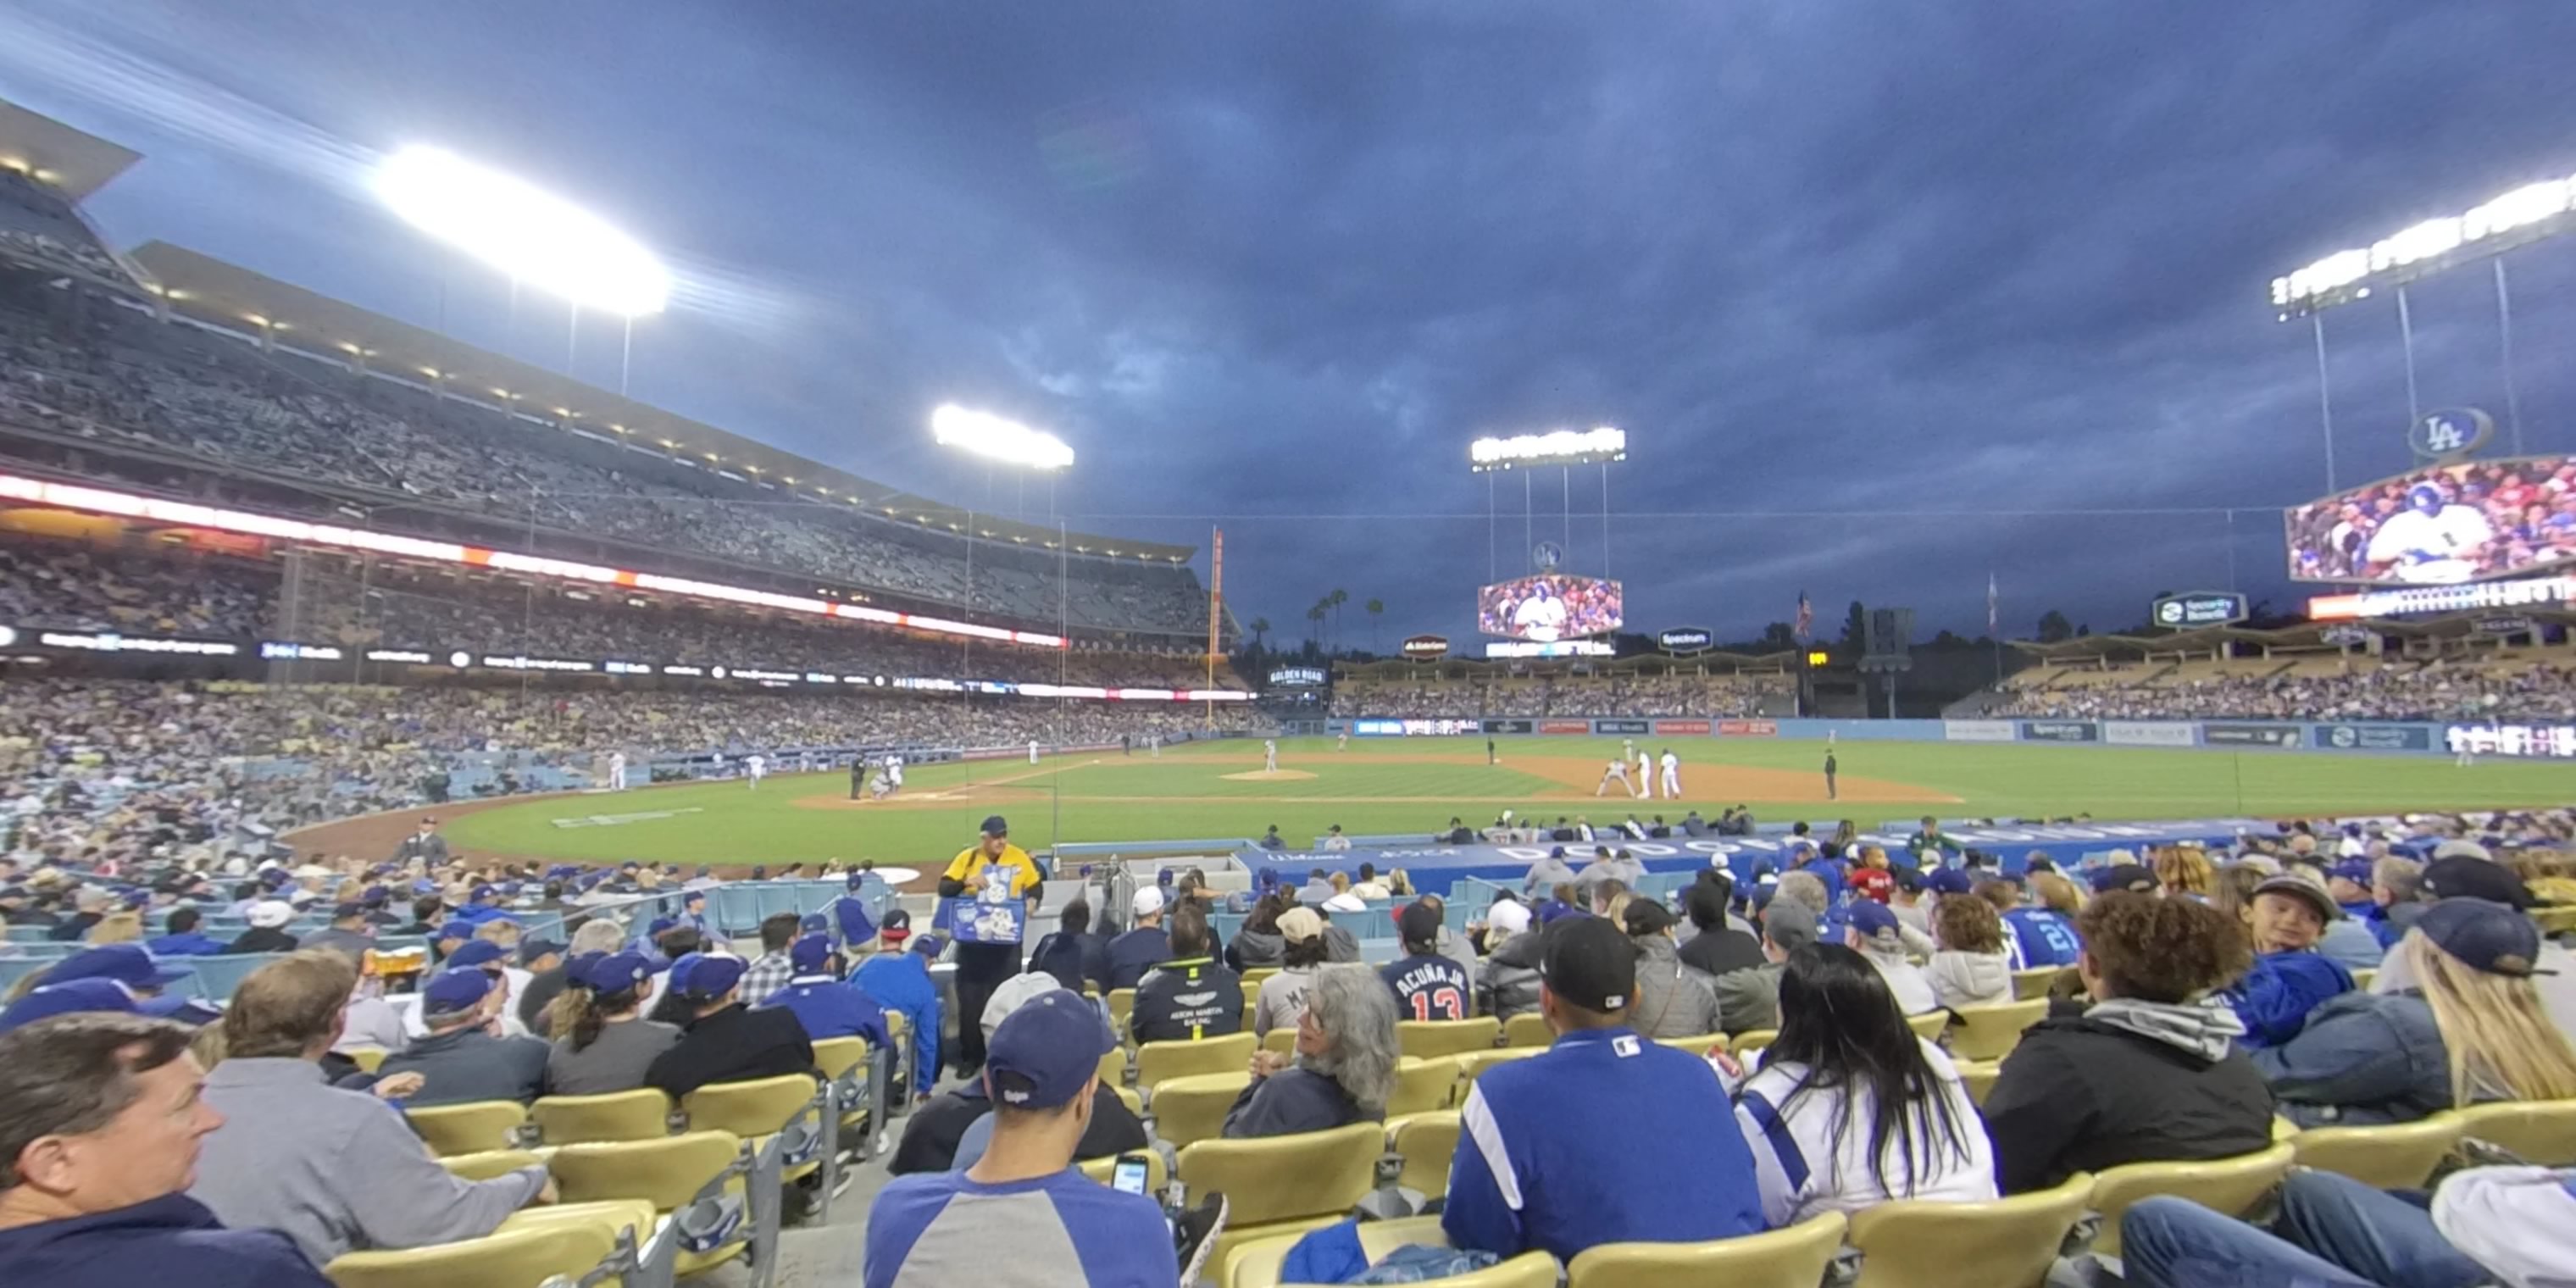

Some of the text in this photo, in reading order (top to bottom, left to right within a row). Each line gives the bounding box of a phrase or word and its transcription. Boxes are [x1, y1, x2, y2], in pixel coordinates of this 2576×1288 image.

[2425, 416, 2463, 451] LA
[1270, 669, 1323, 683] GOLDEN ROAD
[1396, 963, 1447, 997] ACUÑA
[1410, 986, 1463, 1021] 13
